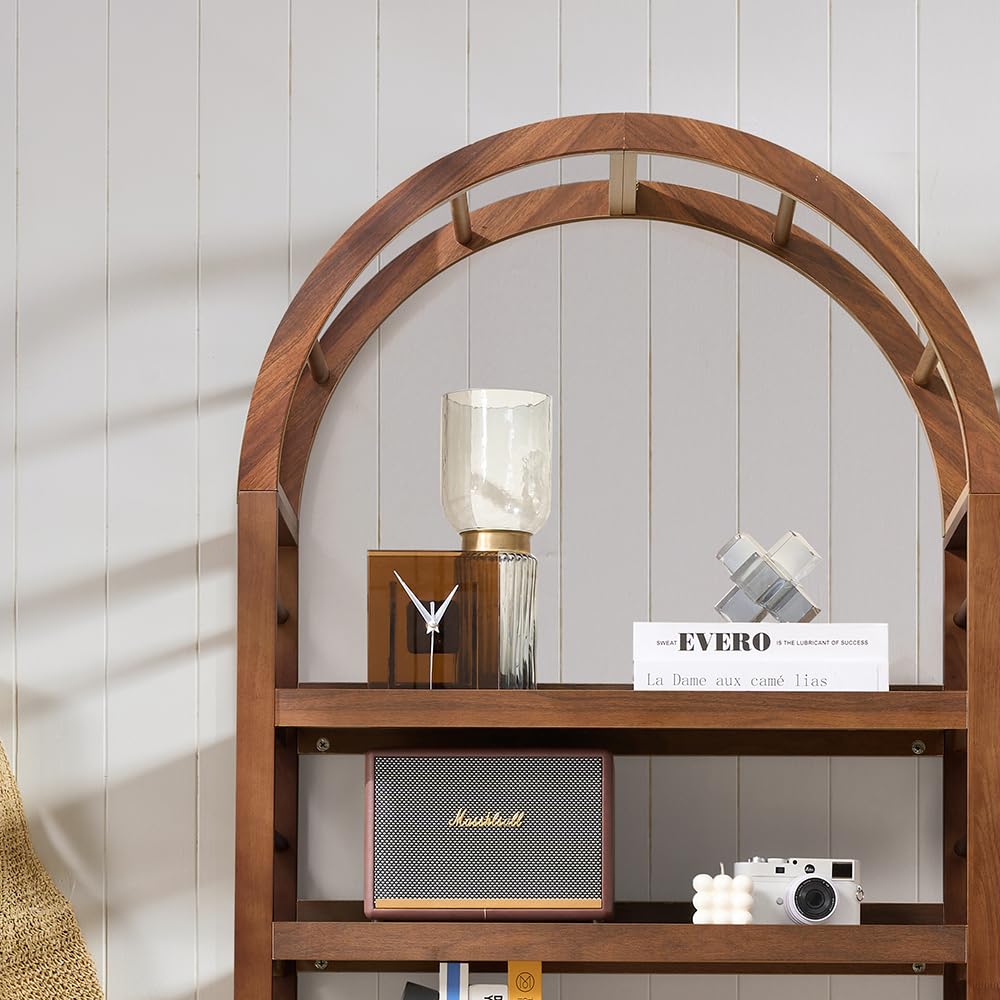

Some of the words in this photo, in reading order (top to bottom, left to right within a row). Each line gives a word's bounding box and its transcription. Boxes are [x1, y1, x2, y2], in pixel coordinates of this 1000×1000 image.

[678, 632, 771, 651] EVERO
[647, 673, 664, 686] La
[673, 673, 707, 686] Dame
[716, 677, 741, 686] aux
[750, 674, 785, 687] camé
[795, 673, 828, 687] lias
